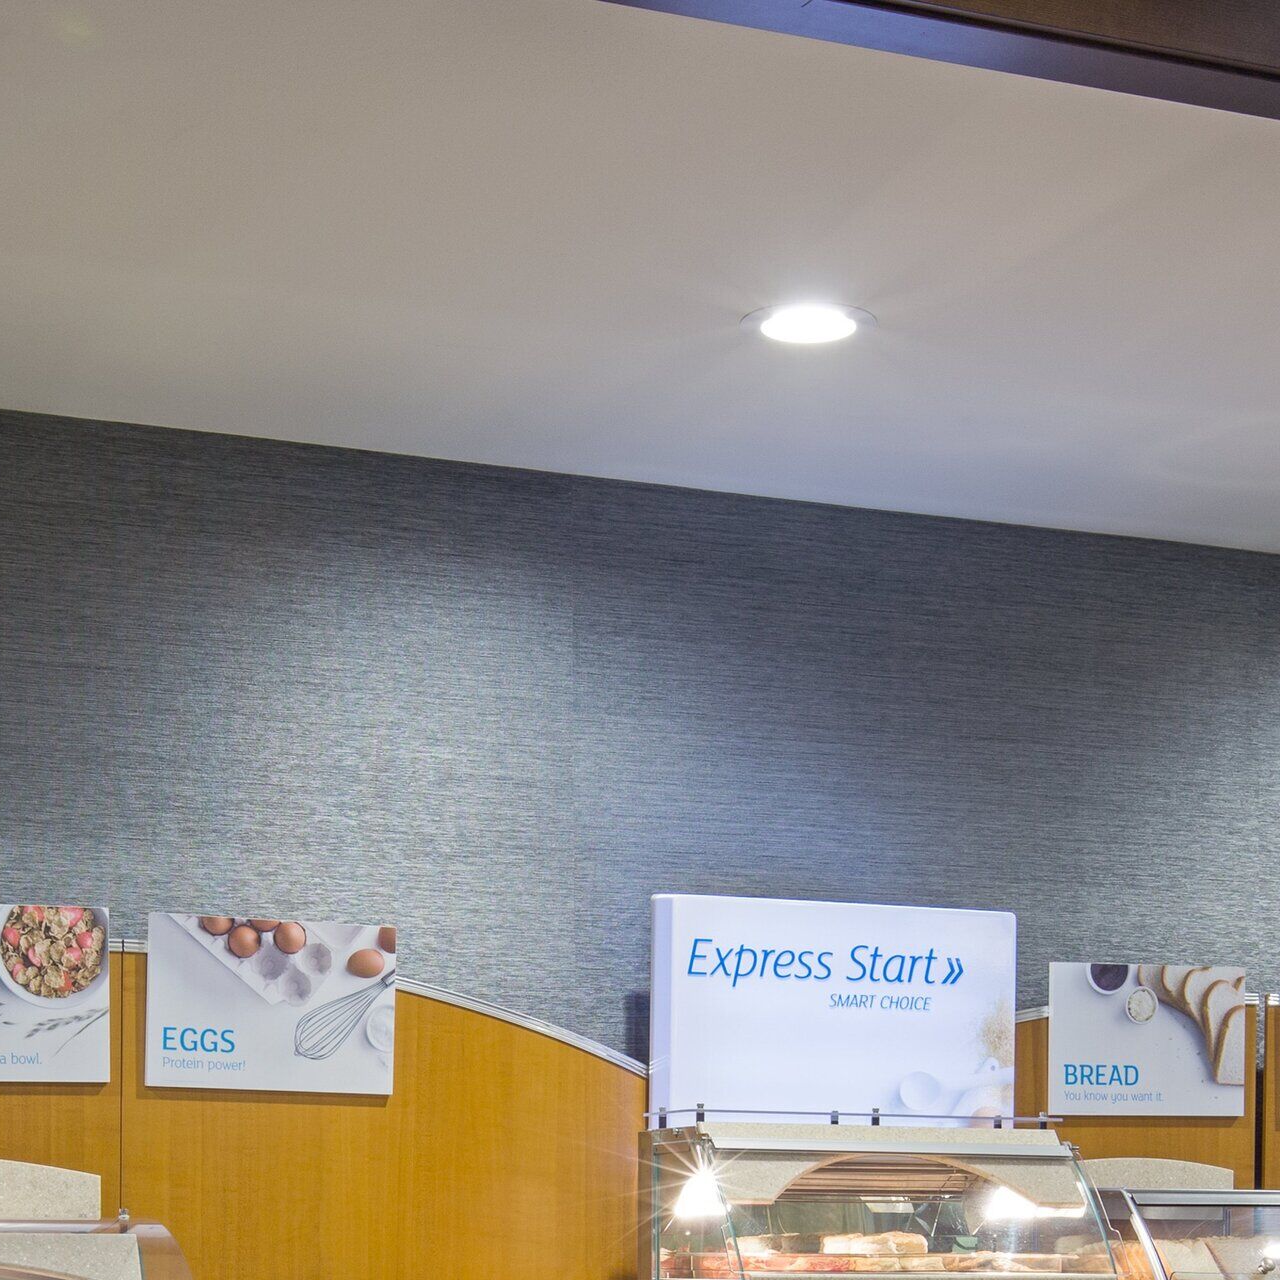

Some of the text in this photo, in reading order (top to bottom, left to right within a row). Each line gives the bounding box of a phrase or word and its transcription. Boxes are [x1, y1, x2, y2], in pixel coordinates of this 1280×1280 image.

[686, 937, 938, 988] Express Start
[828, 993, 931, 1012] SMART CHOICE
[162, 1026, 236, 1053] EGGS
[0, 1055, 8, 1065] a
[11, 1052, 43, 1066] bowl.
[162, 1056, 247, 1073] Protein power!
[1063, 1063, 1140, 1087] BREAD
[1064, 1090, 1081, 1101] You
[1084, 1090, 1109, 1102] know
[1111, 1092, 1129, 1105] you
[1131, 1091, 1153, 1103] want
